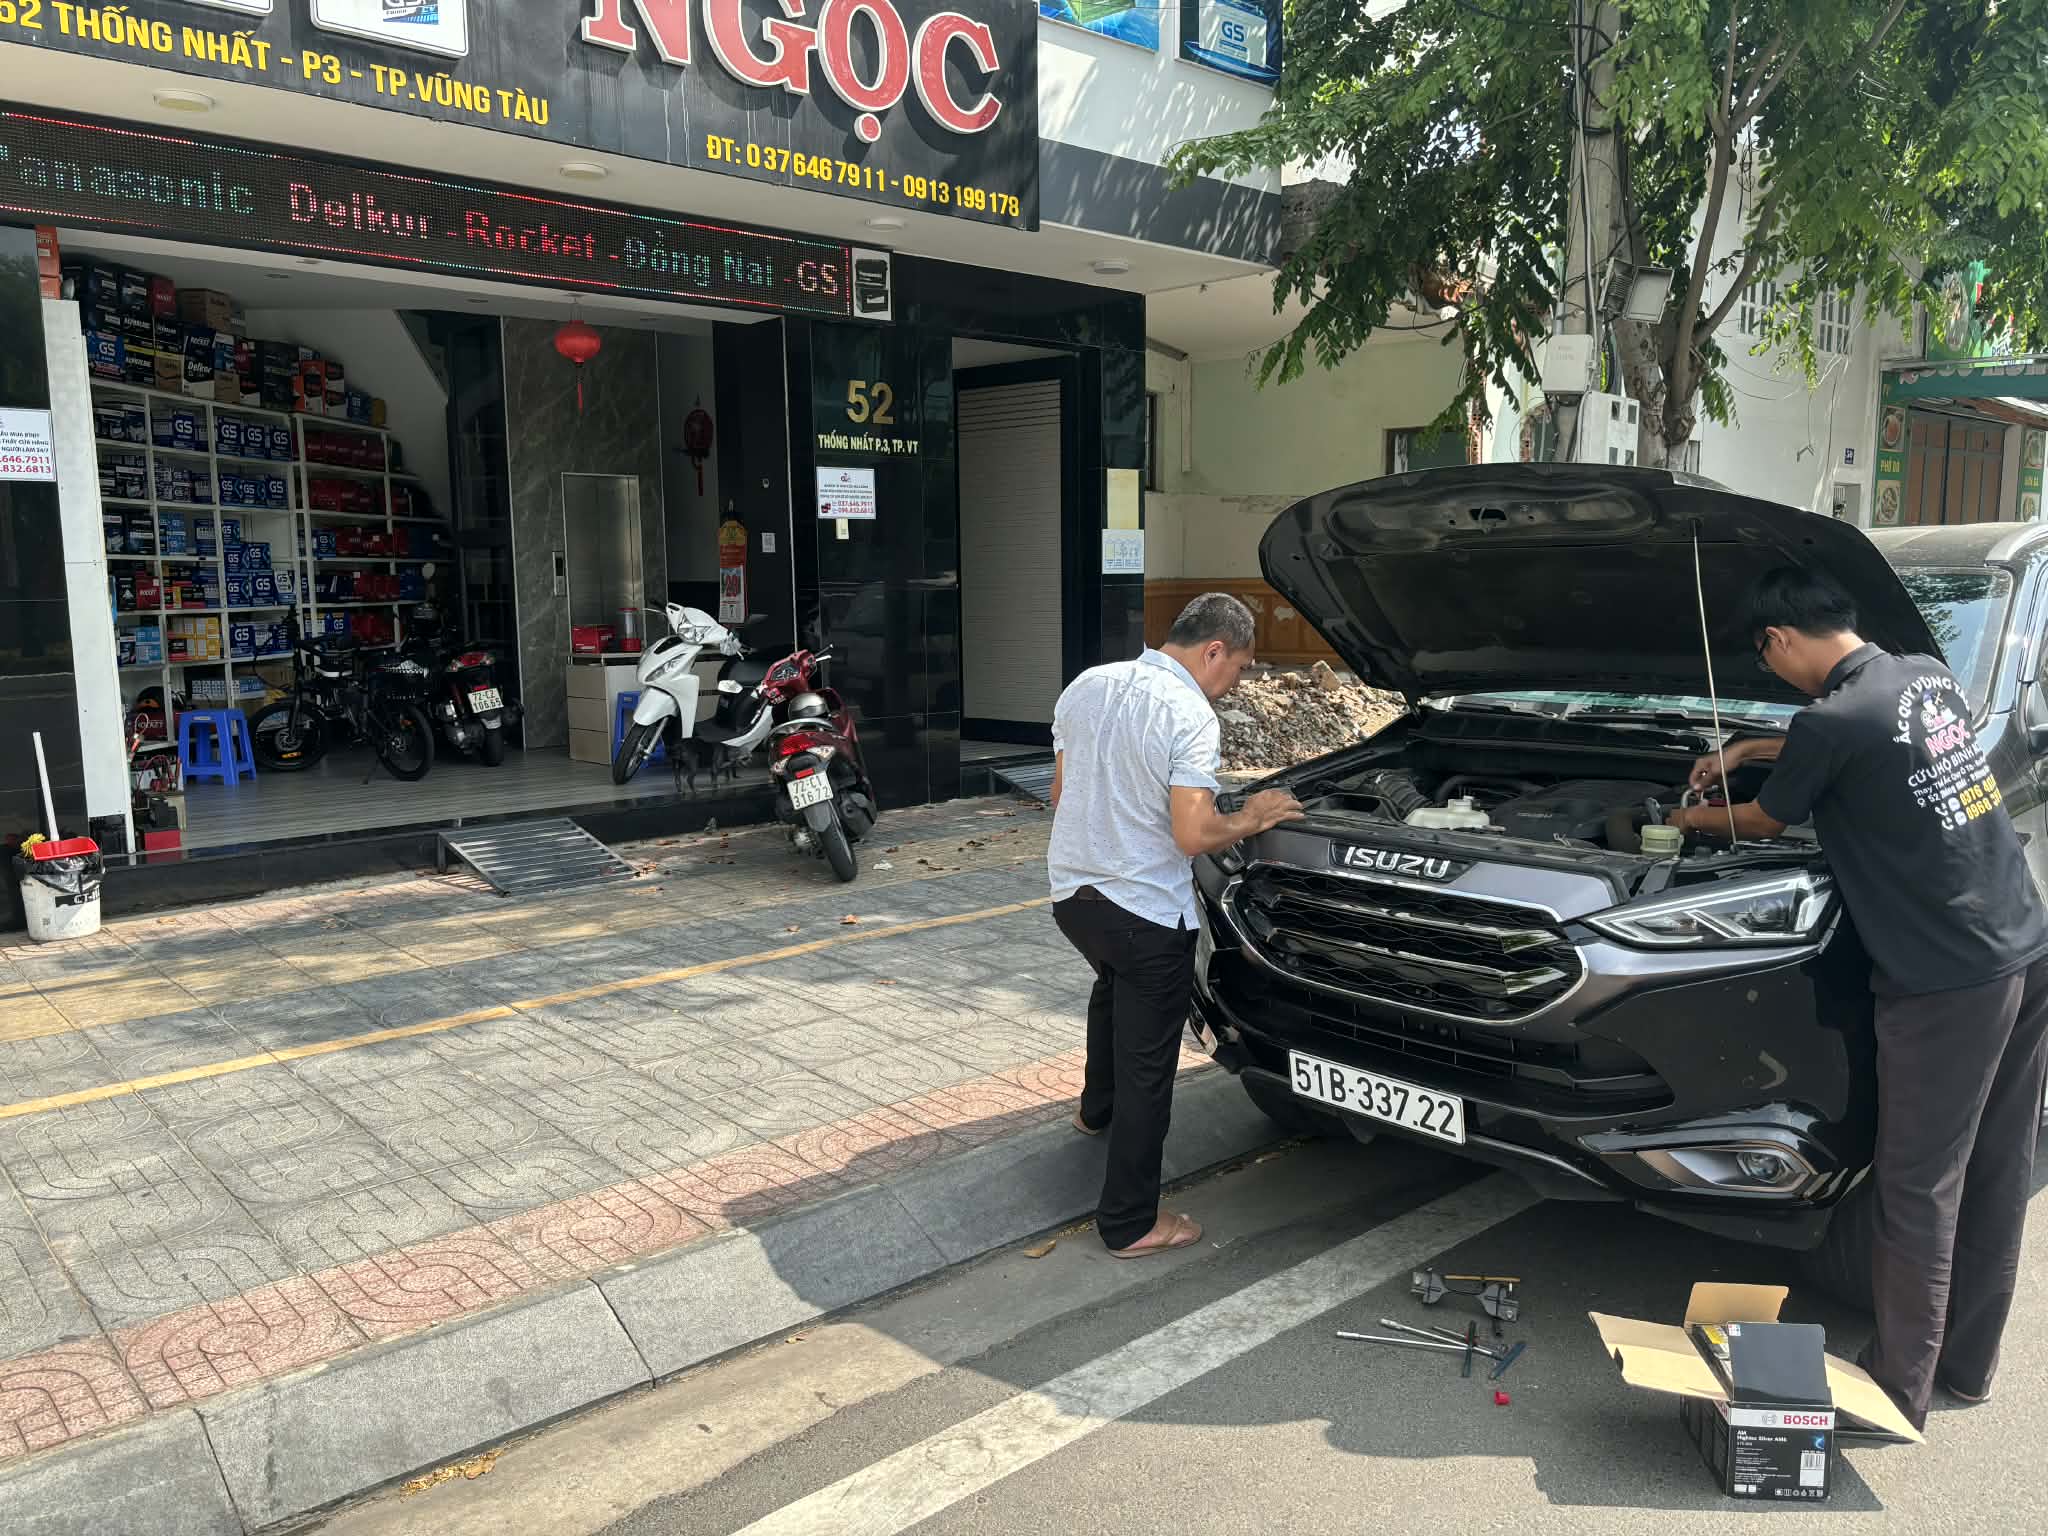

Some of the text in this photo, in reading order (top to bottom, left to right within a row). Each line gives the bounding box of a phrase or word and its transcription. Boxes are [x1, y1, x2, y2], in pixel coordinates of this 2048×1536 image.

[1222, 21, 1245, 42] GS
[52, 2, 173, 52] THỐNG
[182, 26, 271, 71] NHẤT
[302, 50, 341, 84] P3
[370, 63, 491, 114] TP.VŨNG
[497, 88, 549, 125] TÀU
[582, 0, 1002, 144] NGỌC
[706, 134, 741, 164] ĐT:
[99, 341, 116, 357] GS
[847, 380, 894, 425] 52
[175, 419, 193, 434] GS
[221, 424, 237, 438] GS
[247, 426, 263, 441] GS
[273, 431, 288, 445] GS
[818, 429, 849, 450] THỐNG
[850, 432, 873, 451] NHẤT
[907, 440, 918, 454] VT
[222, 479, 233, 491] GS
[243, 483, 255, 494] GS
[269, 480, 284, 493] GS
[227, 553, 239, 565] GS
[250, 548, 261, 558] GS
[227, 582, 239, 593] GS
[256, 577, 271, 591] GS
[235, 628, 250, 641] GS
[1343, 846, 1450, 879] ISUZU
[1295, 1057, 1457, 1138] 51B-337.22
[1783, 1414, 1829, 1426] BOSCH
